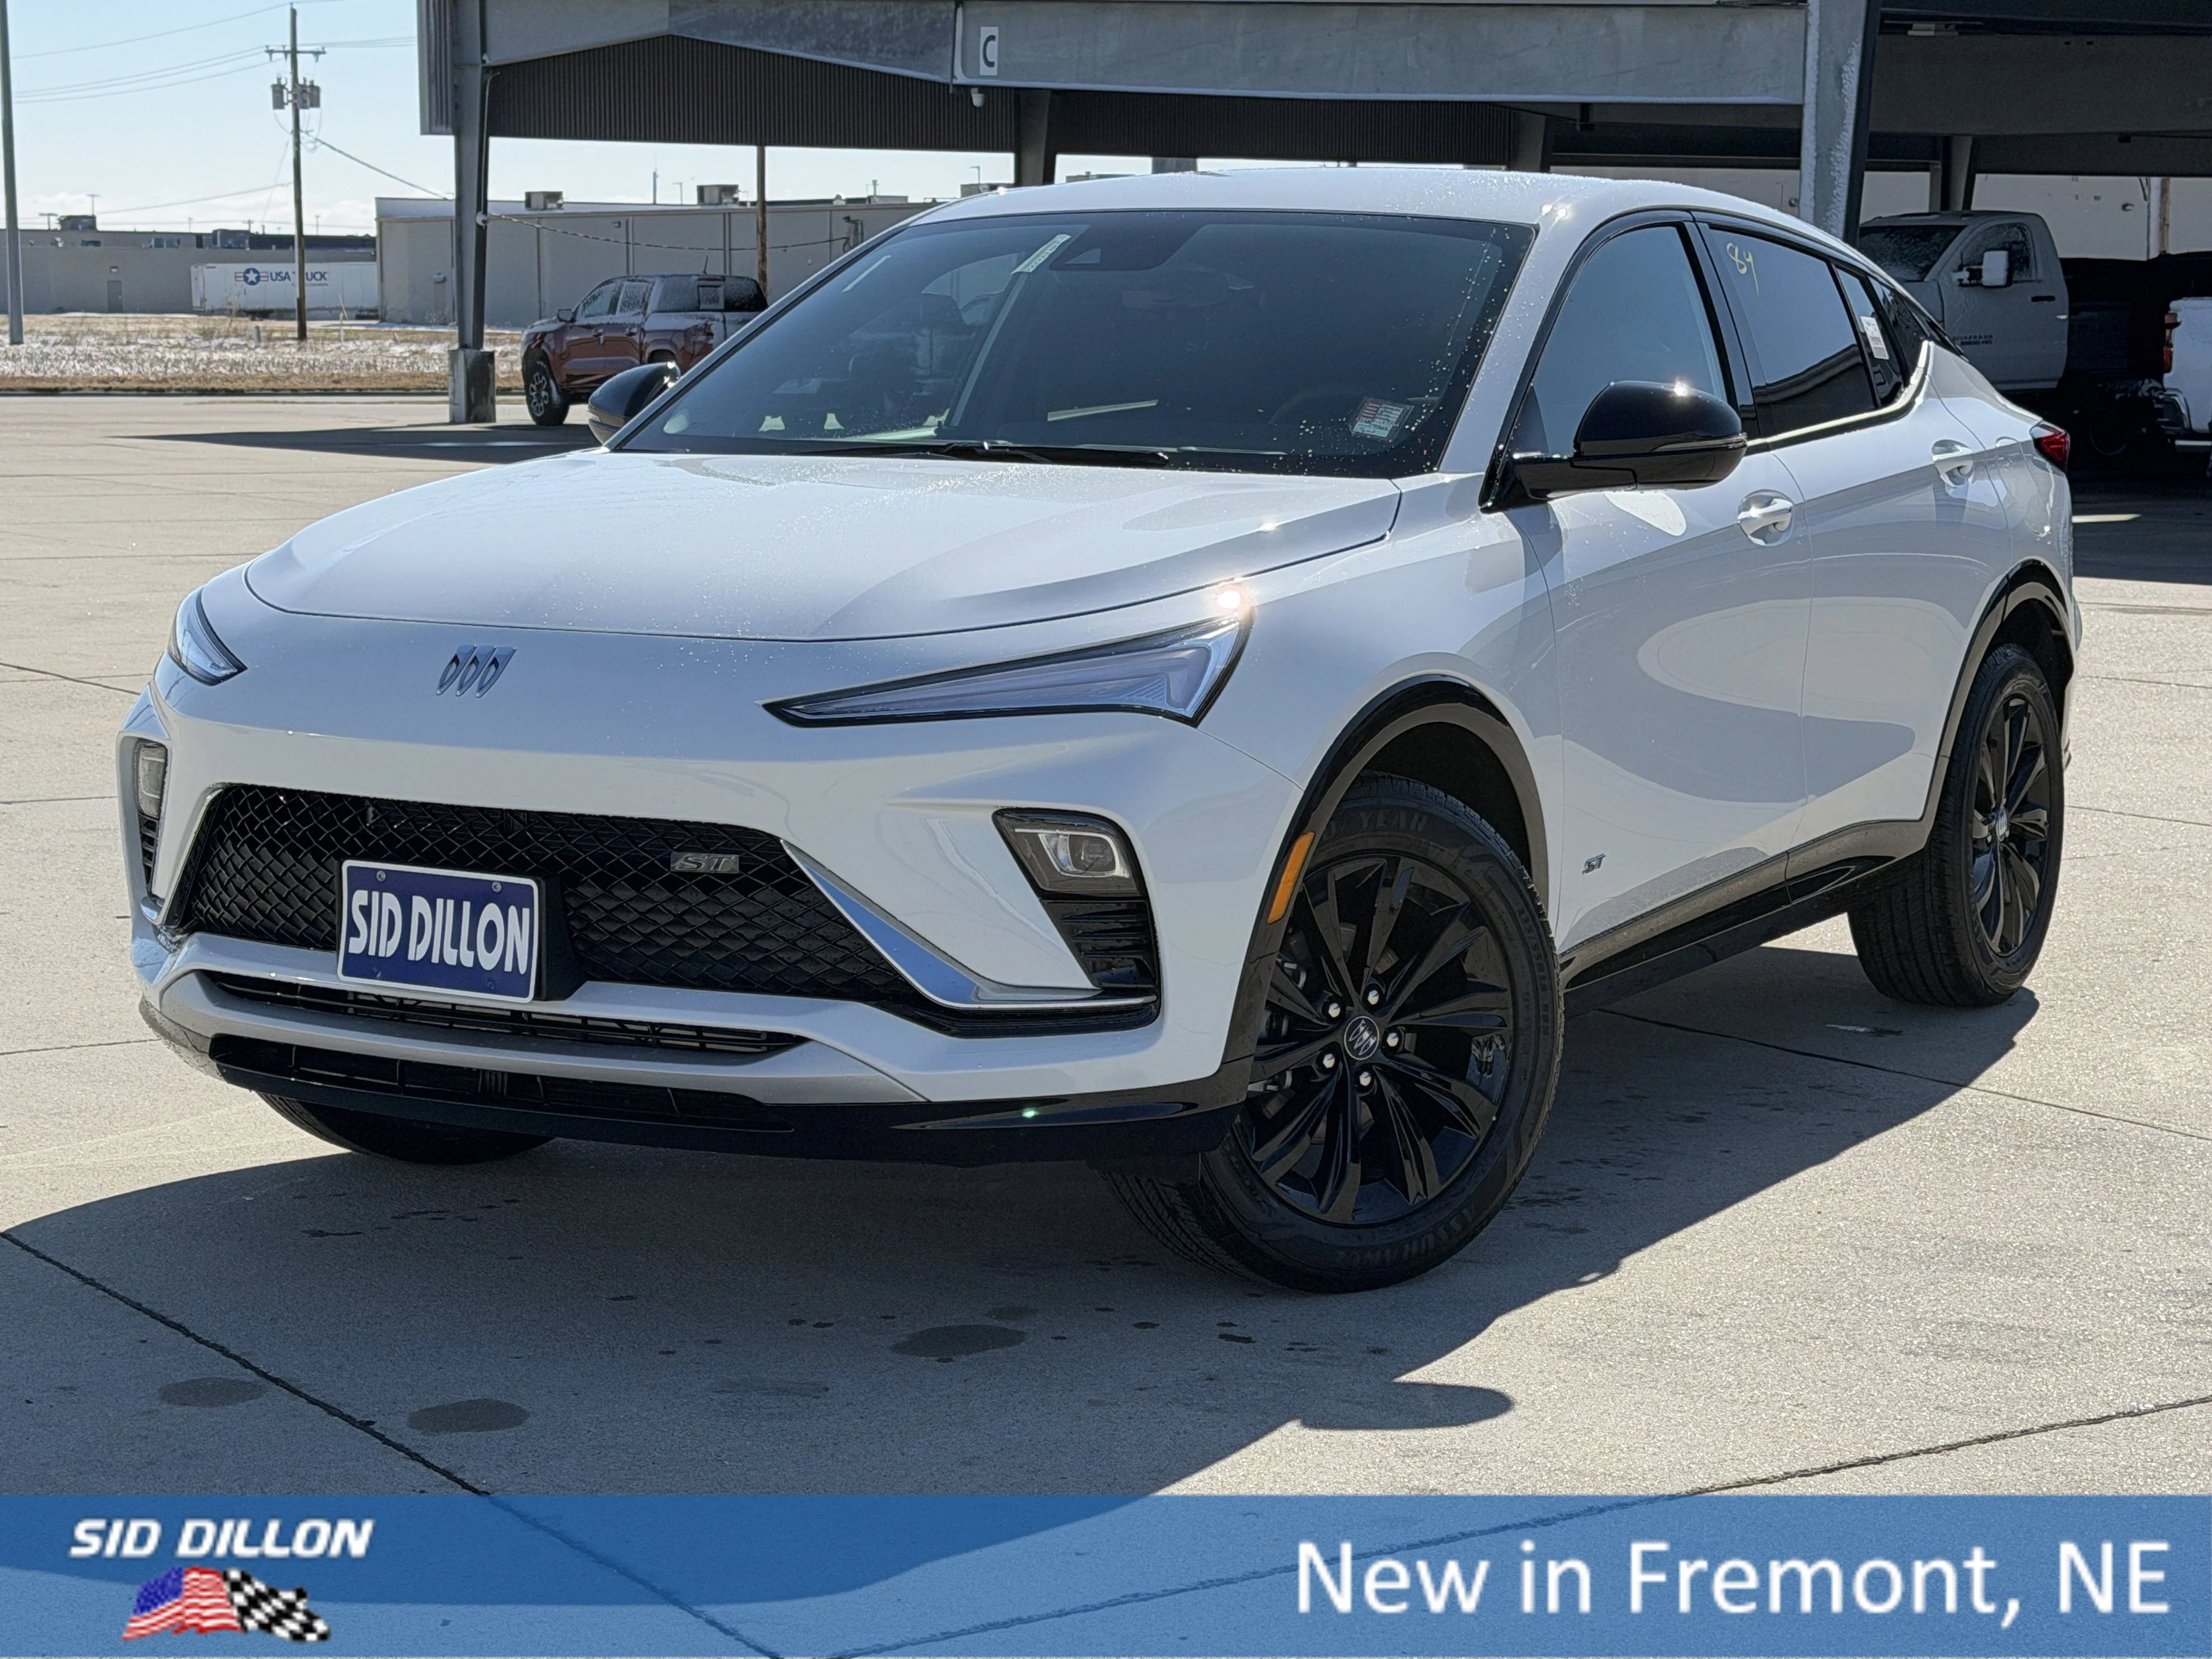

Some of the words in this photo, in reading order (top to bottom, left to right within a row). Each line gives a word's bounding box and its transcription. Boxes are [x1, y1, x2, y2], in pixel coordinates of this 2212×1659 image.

[982, 34, 996, 68] C
[269, 271, 291, 281] USA
[348, 889, 403, 958] SID
[407, 895, 531, 975] DILLON
